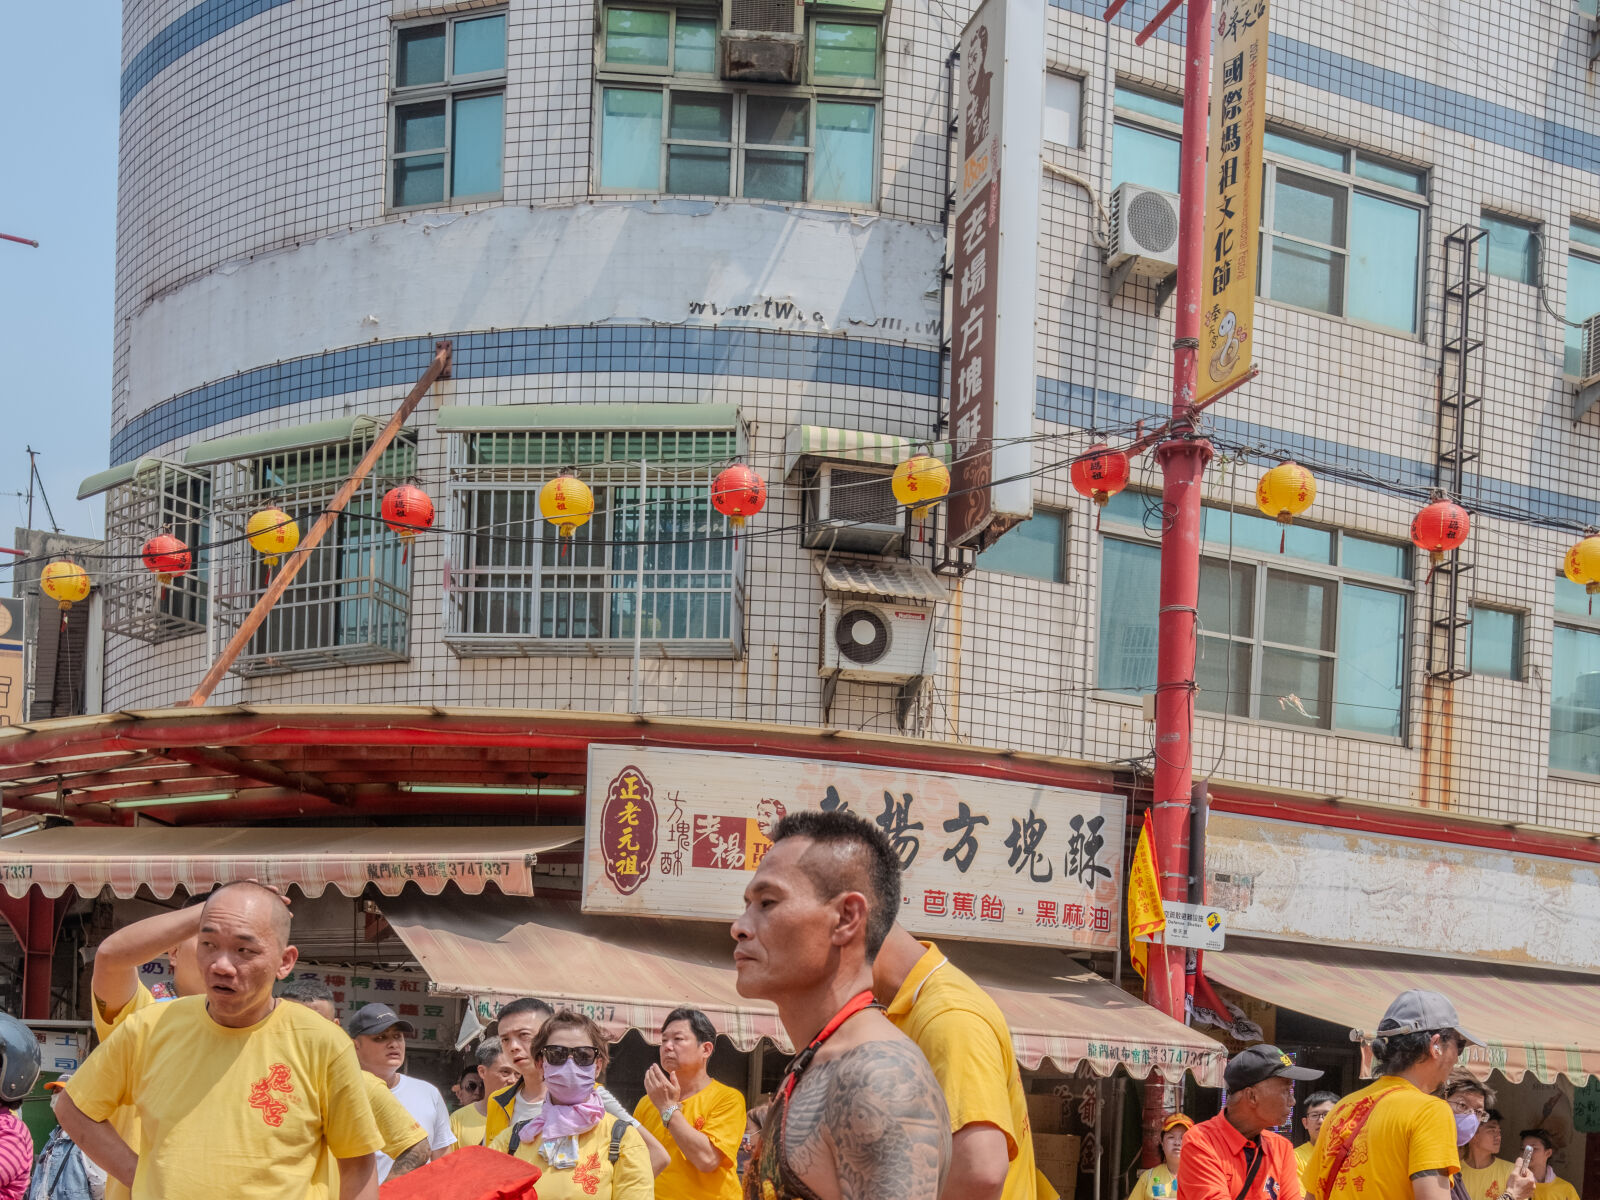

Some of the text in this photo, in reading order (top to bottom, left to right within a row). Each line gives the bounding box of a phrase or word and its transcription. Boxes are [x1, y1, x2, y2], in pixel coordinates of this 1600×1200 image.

[1212, 51, 1243, 296] 國際媽祖文化節
[956, 201, 986, 459] 老楊方塊酥
[616, 776, 642, 875] 正老元祖
[661, 790, 690, 877] 方塊酥
[693, 815, 746, 870] 老楊
[449, 862, 510, 877] 3747337
[923, 889, 1111, 931] 芭蕉飴 黑麻油
